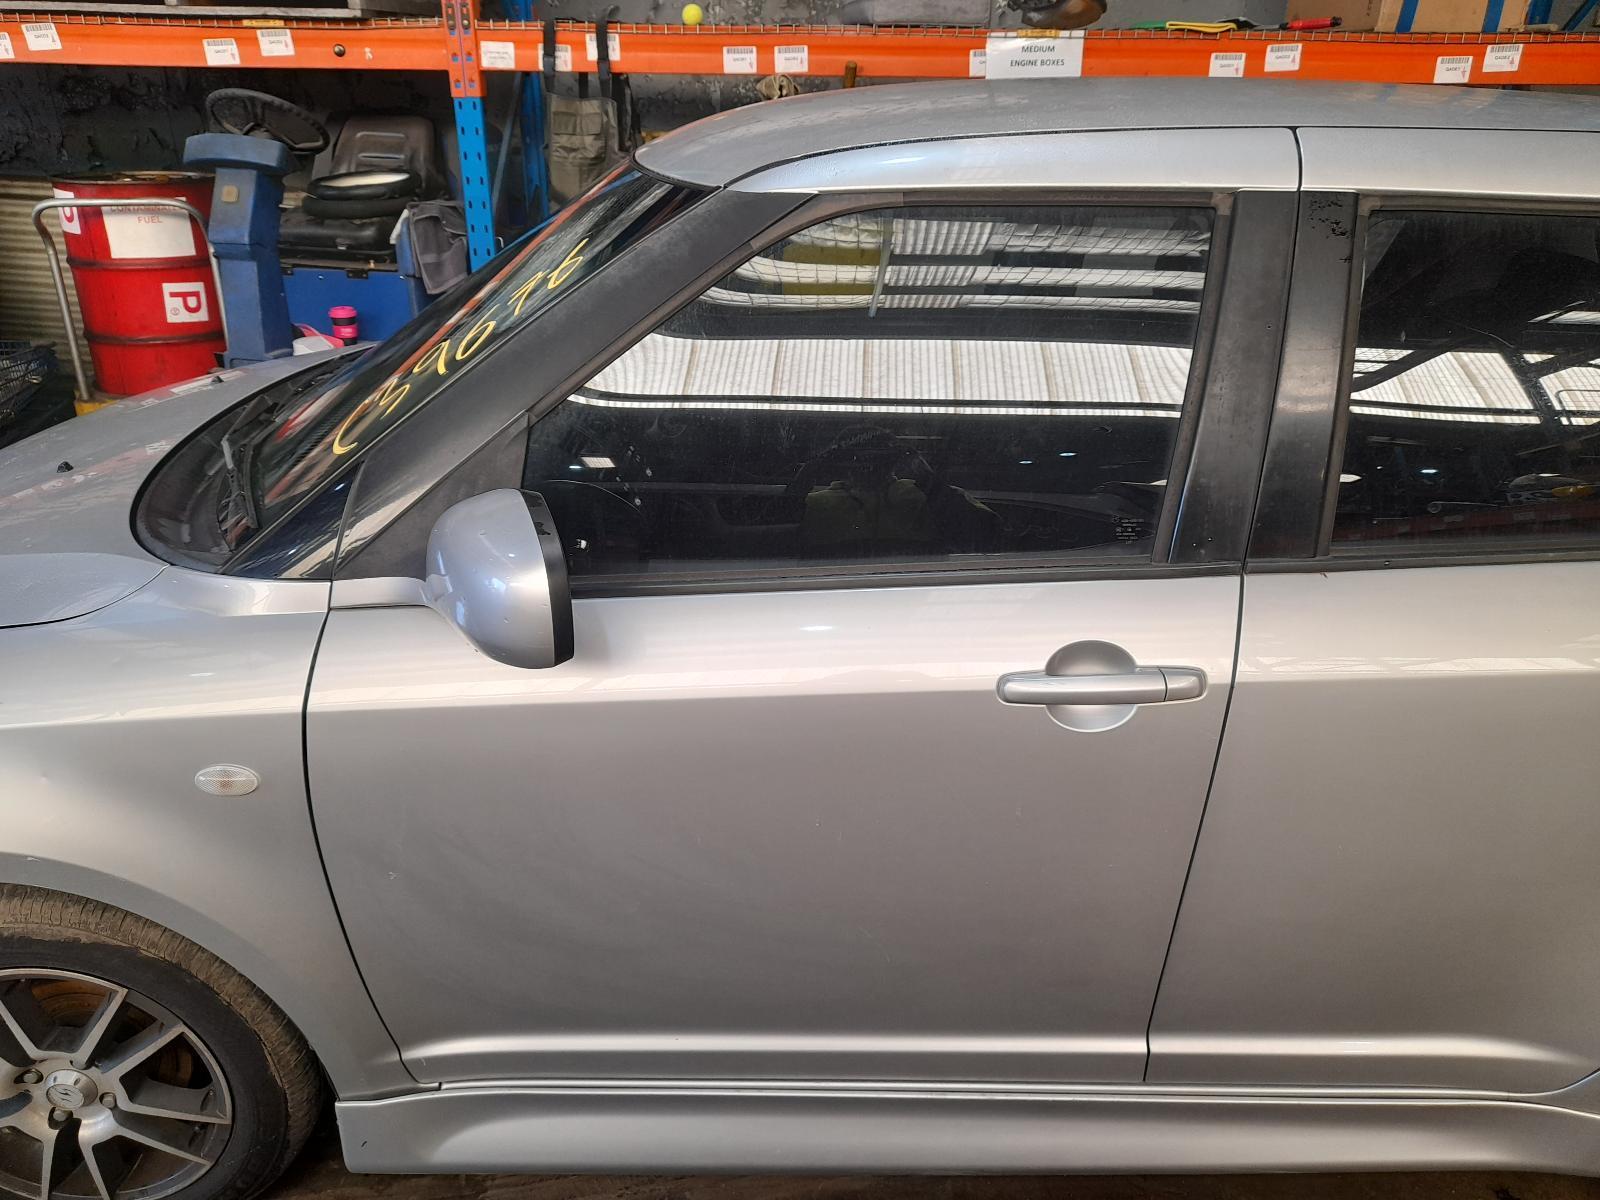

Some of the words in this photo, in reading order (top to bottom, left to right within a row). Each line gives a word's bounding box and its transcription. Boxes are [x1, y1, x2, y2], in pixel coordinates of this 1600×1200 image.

[1021, 45, 1056, 54] MEDIUM
[1010, 59, 1039, 67] ENGINE
[1040, 58, 1065, 67] BOXES
[137, 216, 164, 224] FUEL
